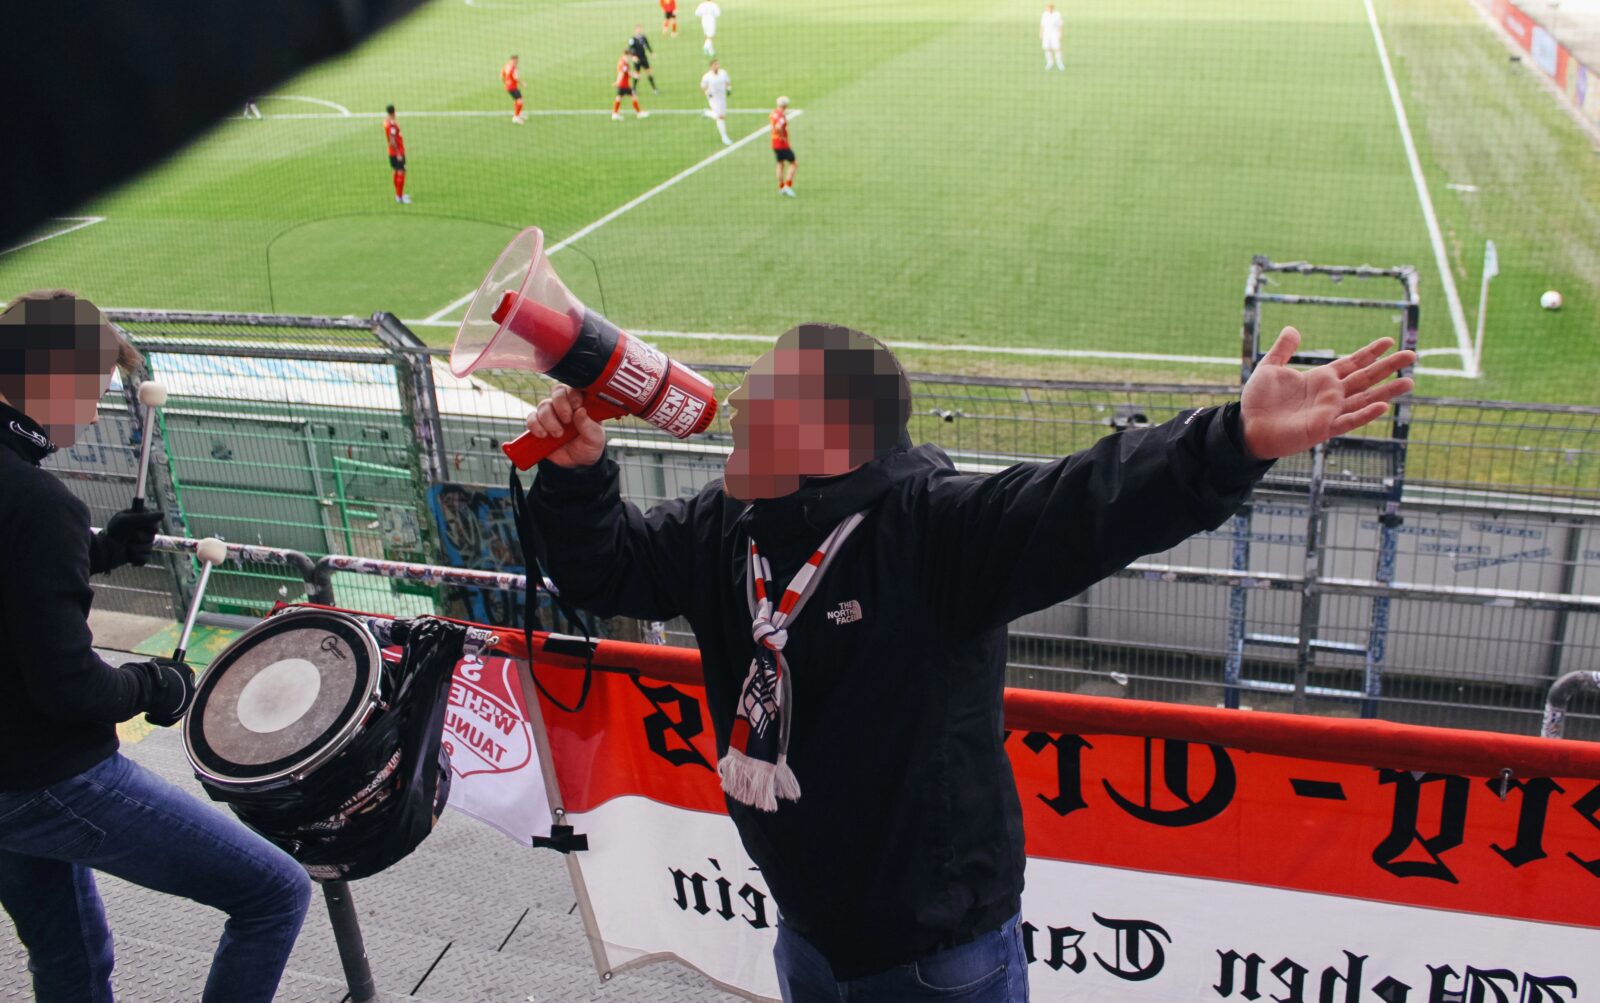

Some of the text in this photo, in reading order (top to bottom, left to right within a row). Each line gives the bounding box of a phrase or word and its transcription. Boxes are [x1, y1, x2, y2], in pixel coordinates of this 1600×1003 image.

[667, 398, 702, 437] CISM
[838, 601, 854, 610] THE
[827, 608, 856, 620] NORTH
[836, 615, 858, 625] FACE
